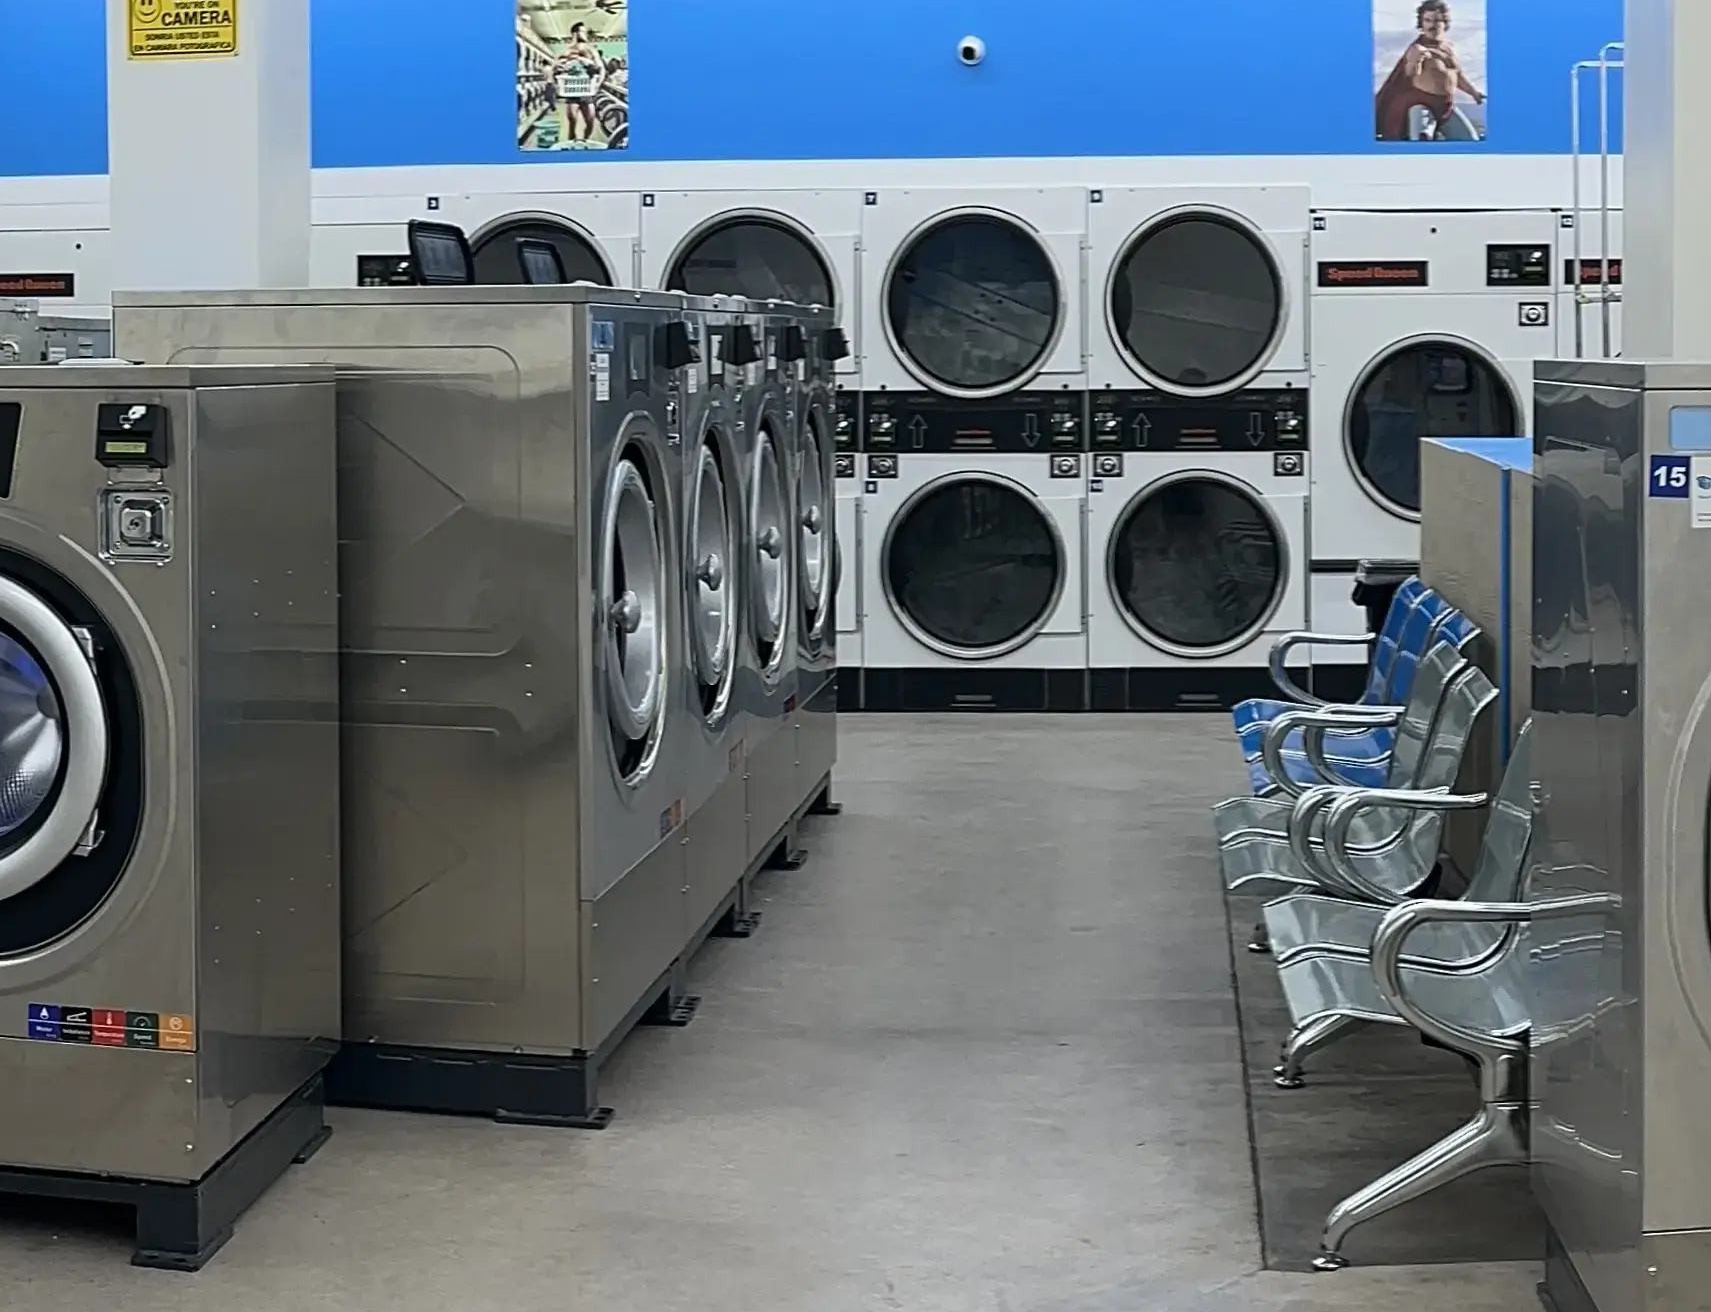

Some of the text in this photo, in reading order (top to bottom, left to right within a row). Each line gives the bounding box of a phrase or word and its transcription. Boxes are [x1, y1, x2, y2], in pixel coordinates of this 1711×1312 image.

[161, 10, 232, 27] CAMERA
[1327, 267, 1373, 281] Speed
[1653, 465, 1687, 487] 15
